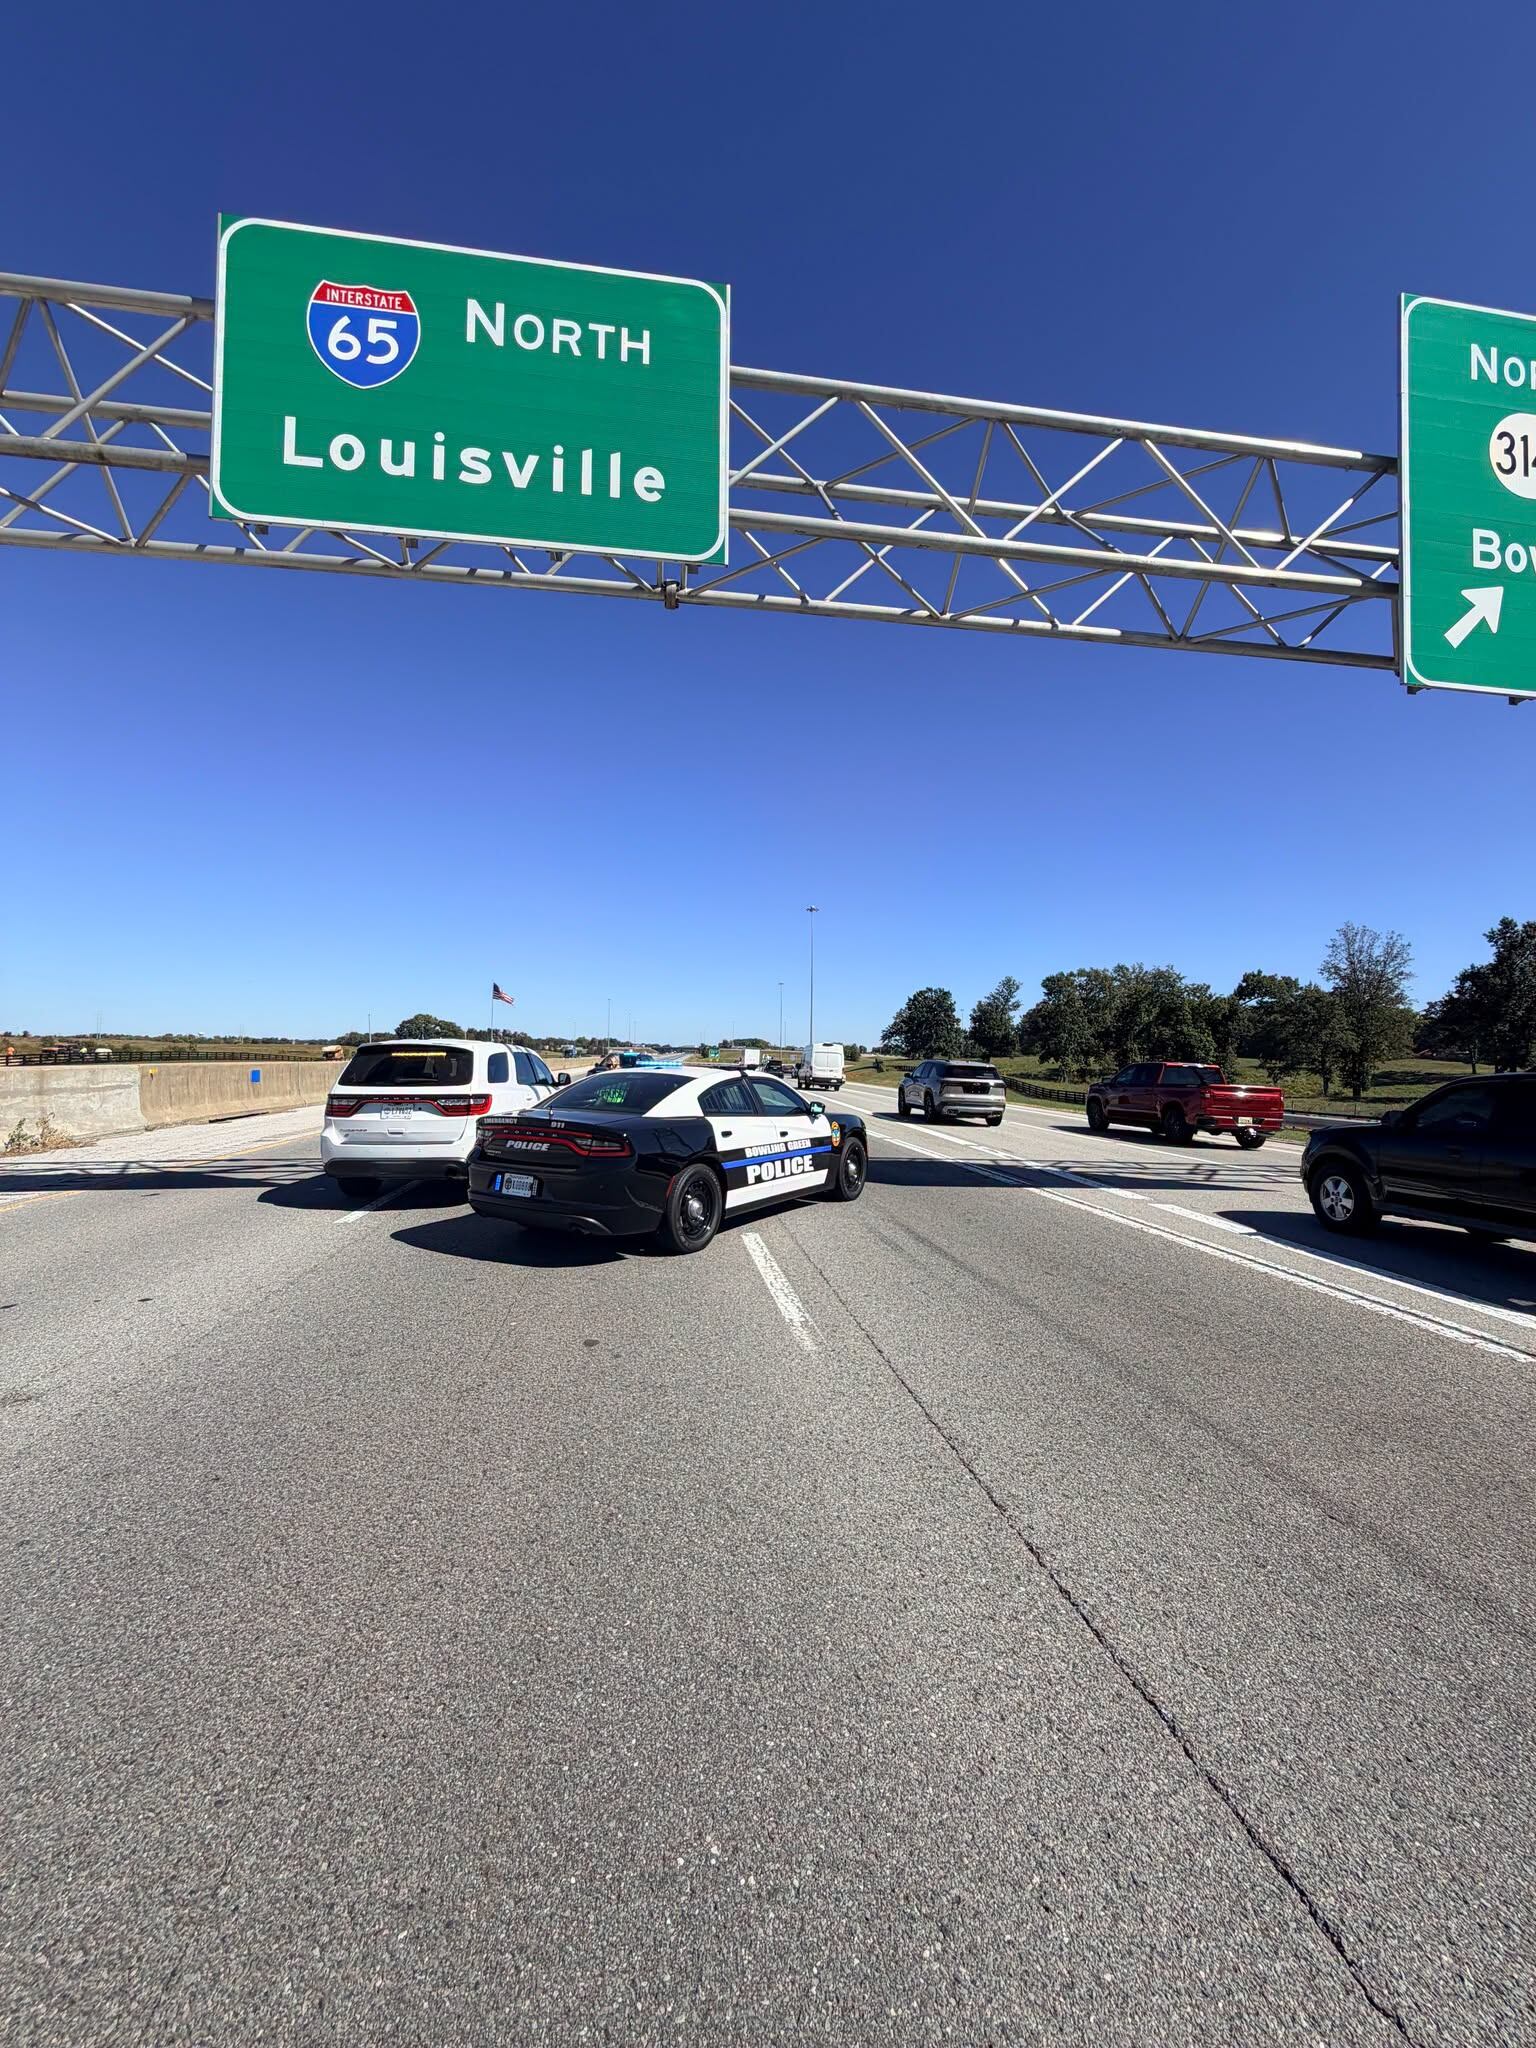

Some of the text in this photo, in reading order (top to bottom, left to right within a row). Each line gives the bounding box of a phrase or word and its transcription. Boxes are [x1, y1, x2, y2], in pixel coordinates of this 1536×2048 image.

[326, 287, 403, 310] INTERSTATE
[327, 315, 399, 365] 65
[466, 298, 651, 365] NORTH
[283, 415, 666, 502] Louisville
[1495, 431, 1536, 478] 31
[506, 1140, 550, 1152] POLICE
[744, 1138, 812, 1158] BOWLING GREEN
[746, 1154, 814, 1185] POLICE
